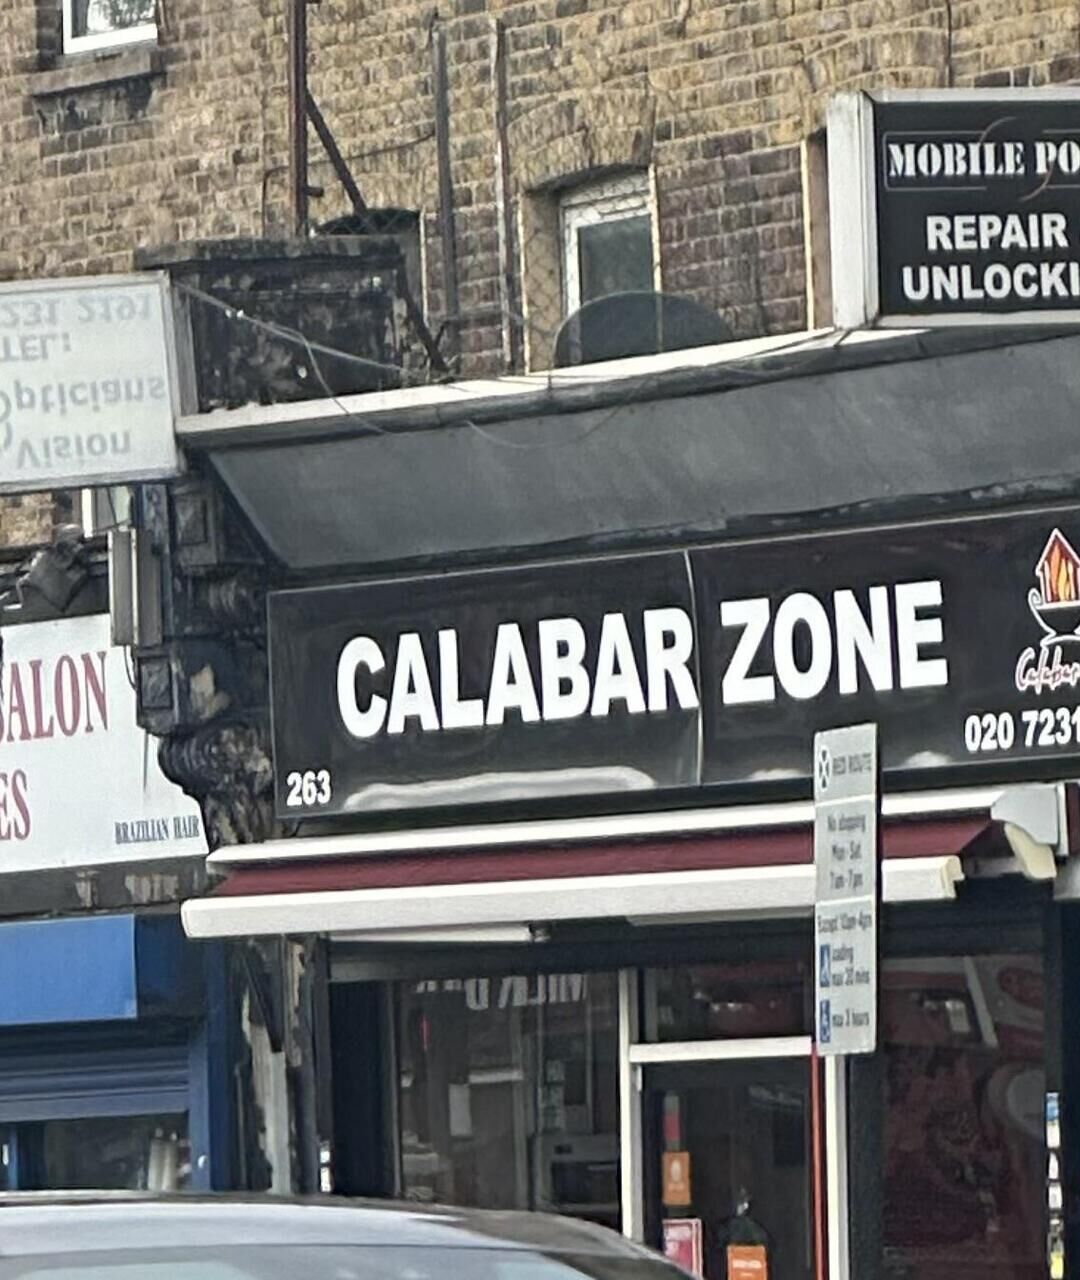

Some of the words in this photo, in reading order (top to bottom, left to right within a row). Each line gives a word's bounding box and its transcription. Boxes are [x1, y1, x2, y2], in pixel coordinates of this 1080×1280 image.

[888, 142, 1025, 176] MOBILE
[926, 213, 1069, 250] REPAIR
[336, 607, 700, 738] CALABAR
[720, 580, 948, 704] ZONE
[0, 650, 108, 743] ALON
[965, 712, 1014, 753] 020
[286, 769, 332, 806] 263
[114, 817, 169, 845] BRAZILIAN
[173, 814, 200, 839] HAIR
